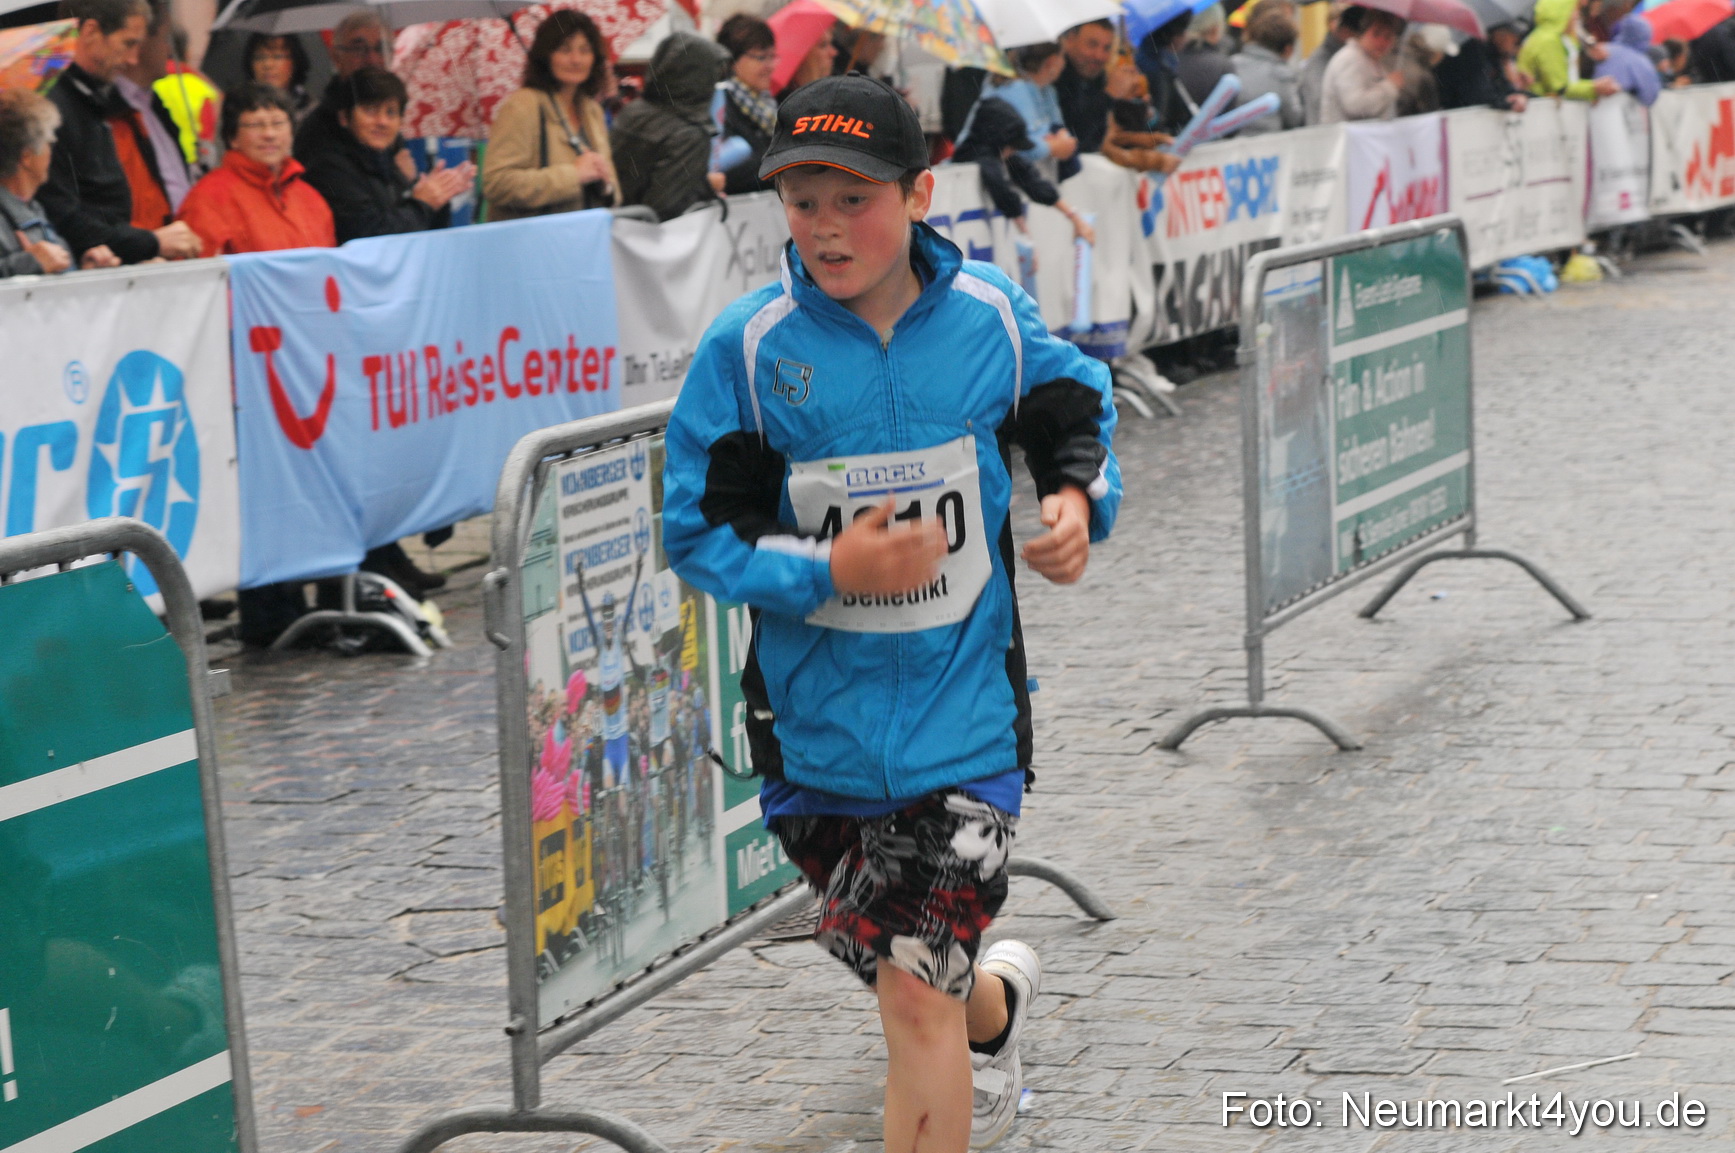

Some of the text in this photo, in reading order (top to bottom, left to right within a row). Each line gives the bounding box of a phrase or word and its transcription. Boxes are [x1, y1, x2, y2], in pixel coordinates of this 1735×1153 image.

[791, 113, 871, 139] STIHL
[362, 326, 616, 432] TUI ReiseCenter
[845, 461, 927, 488] BOCK
